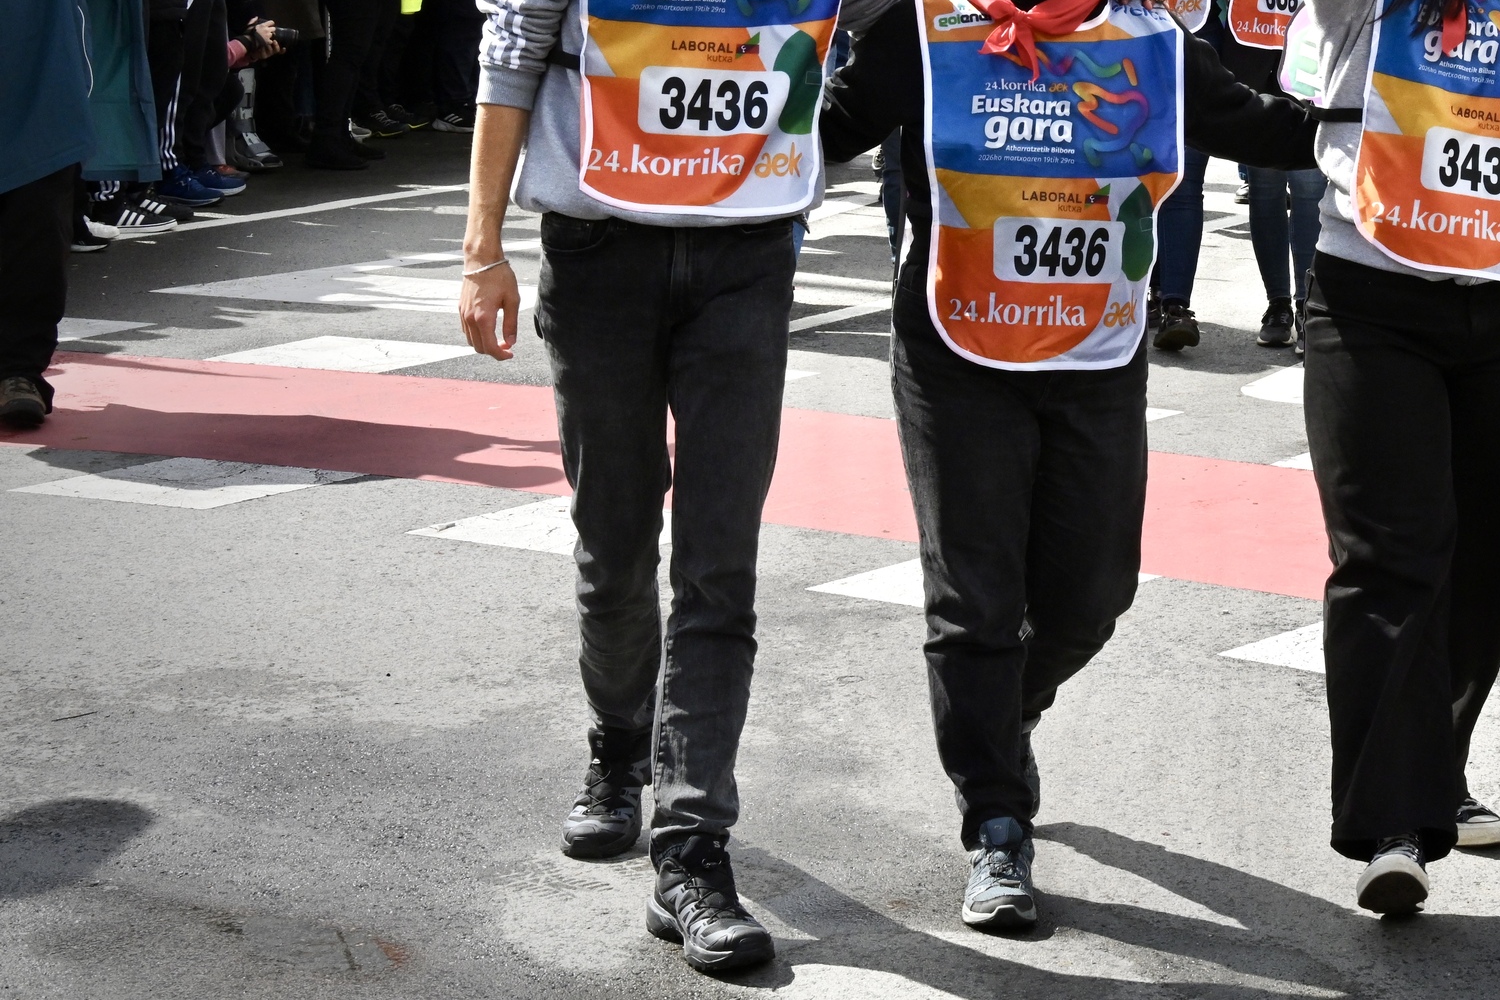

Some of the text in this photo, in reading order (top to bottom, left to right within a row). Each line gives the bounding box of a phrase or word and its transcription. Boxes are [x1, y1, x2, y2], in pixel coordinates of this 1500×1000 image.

[672, 40, 733, 53] LABORAL
[707, 54, 733, 63] kutxa
[659, 76, 769, 131] 3436
[971, 93, 1071, 117] Euskara
[1450, 106, 1500, 122] LABORAL
[984, 116, 1073, 149] gara
[1478, 122, 1500, 132] kutxa
[1006, 144, 1075, 155] Atharratzetik Bilbora
[586, 142, 802, 178] 24.korrika aek
[1022, 190, 1082, 204] LABORAL
[1058, 204, 1082, 213] kutxa
[1014, 224, 1110, 277] 3436
[948, 292, 1087, 327] 24.korrika
